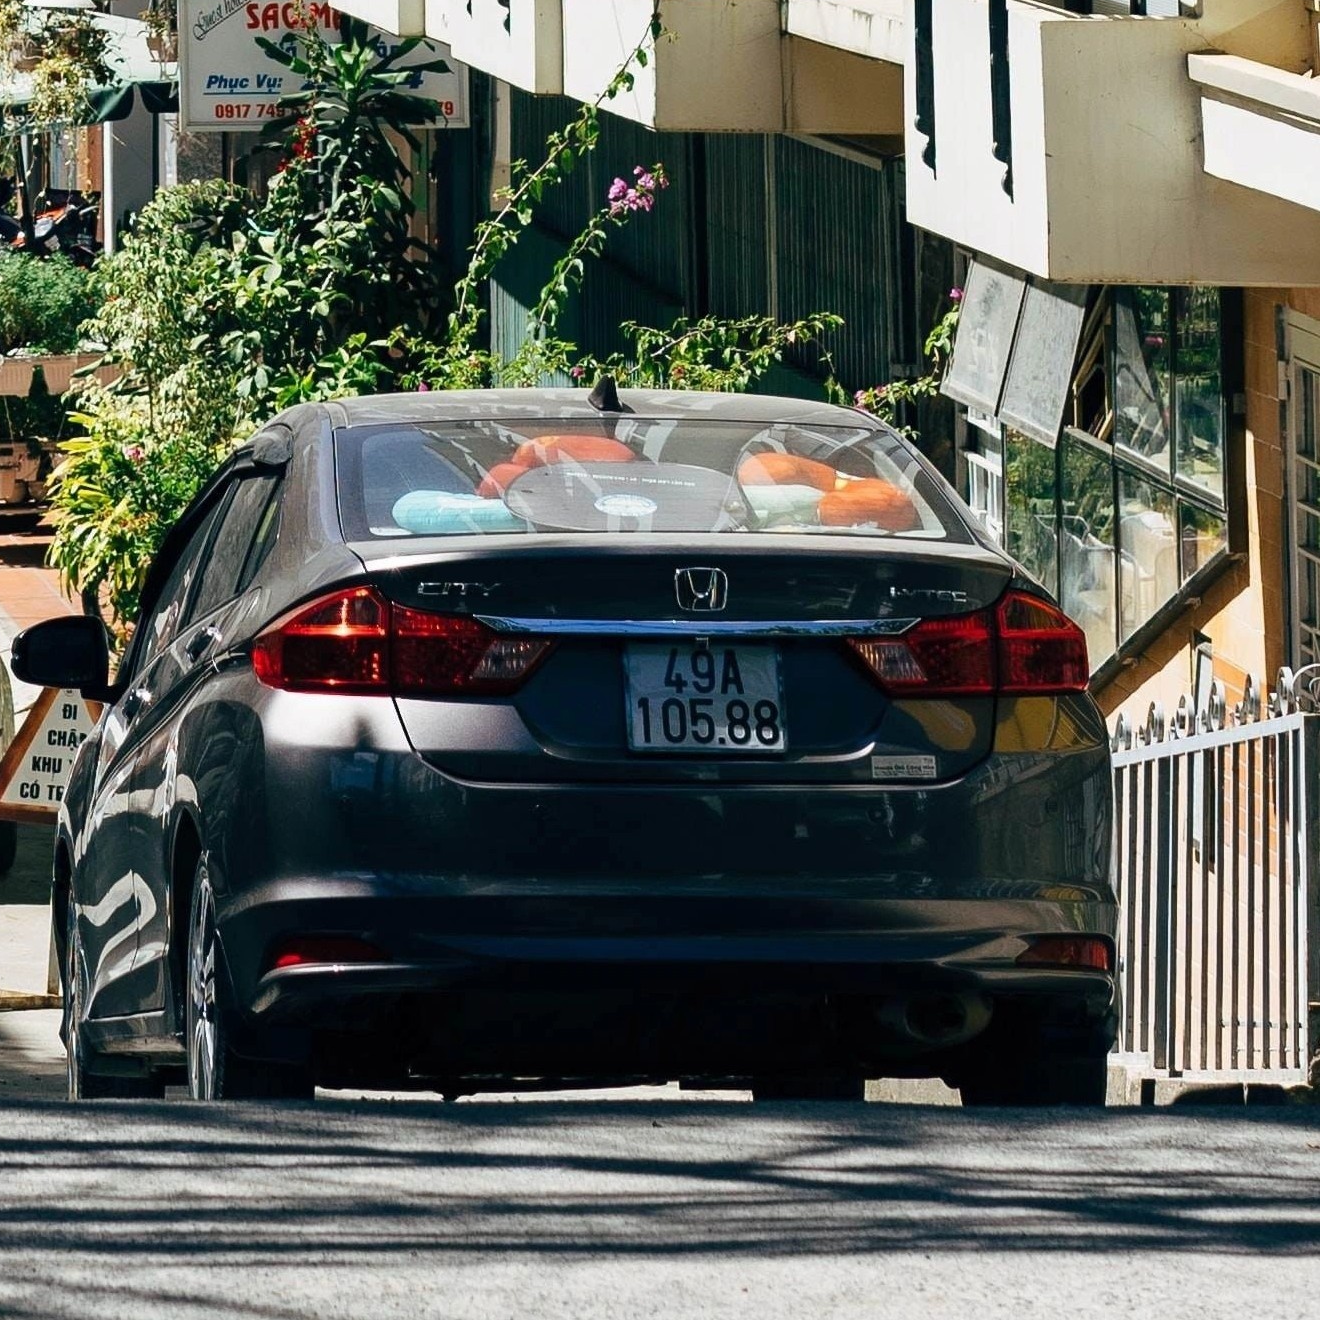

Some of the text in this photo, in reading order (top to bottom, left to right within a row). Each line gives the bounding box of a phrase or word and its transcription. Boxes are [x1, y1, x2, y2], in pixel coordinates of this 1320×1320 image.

[206, 74, 250, 93] Phục
[256, 74, 284, 92] Vụ:
[214, 104, 251, 119] 0917
[664, 648, 745, 695] 49A
[61, 703, 78, 721] ĐI
[637, 696, 781, 746] 105.88
[31, 755, 62, 774] KHU
[19, 779, 40, 800] CÓ
